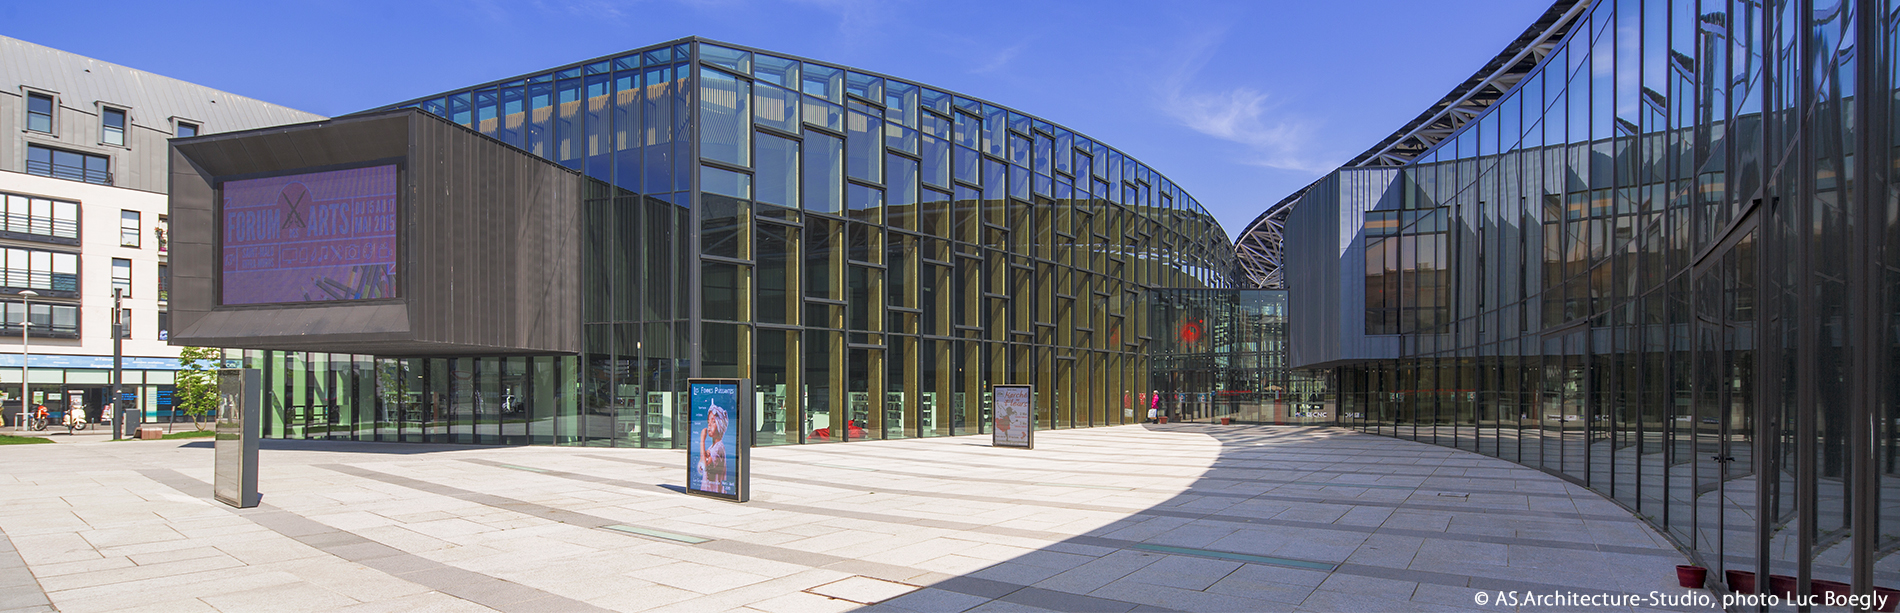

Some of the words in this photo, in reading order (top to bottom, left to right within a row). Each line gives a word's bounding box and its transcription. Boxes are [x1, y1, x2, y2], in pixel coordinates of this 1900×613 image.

[355, 201, 365, 215] DU
[366, 200, 374, 214] 15
[376, 199, 386, 213] AU
[228, 209, 281, 242] FORUM
[306, 202, 350, 237] ARTS
[354, 215, 371, 233] MAI
[373, 214, 395, 232] 2015
